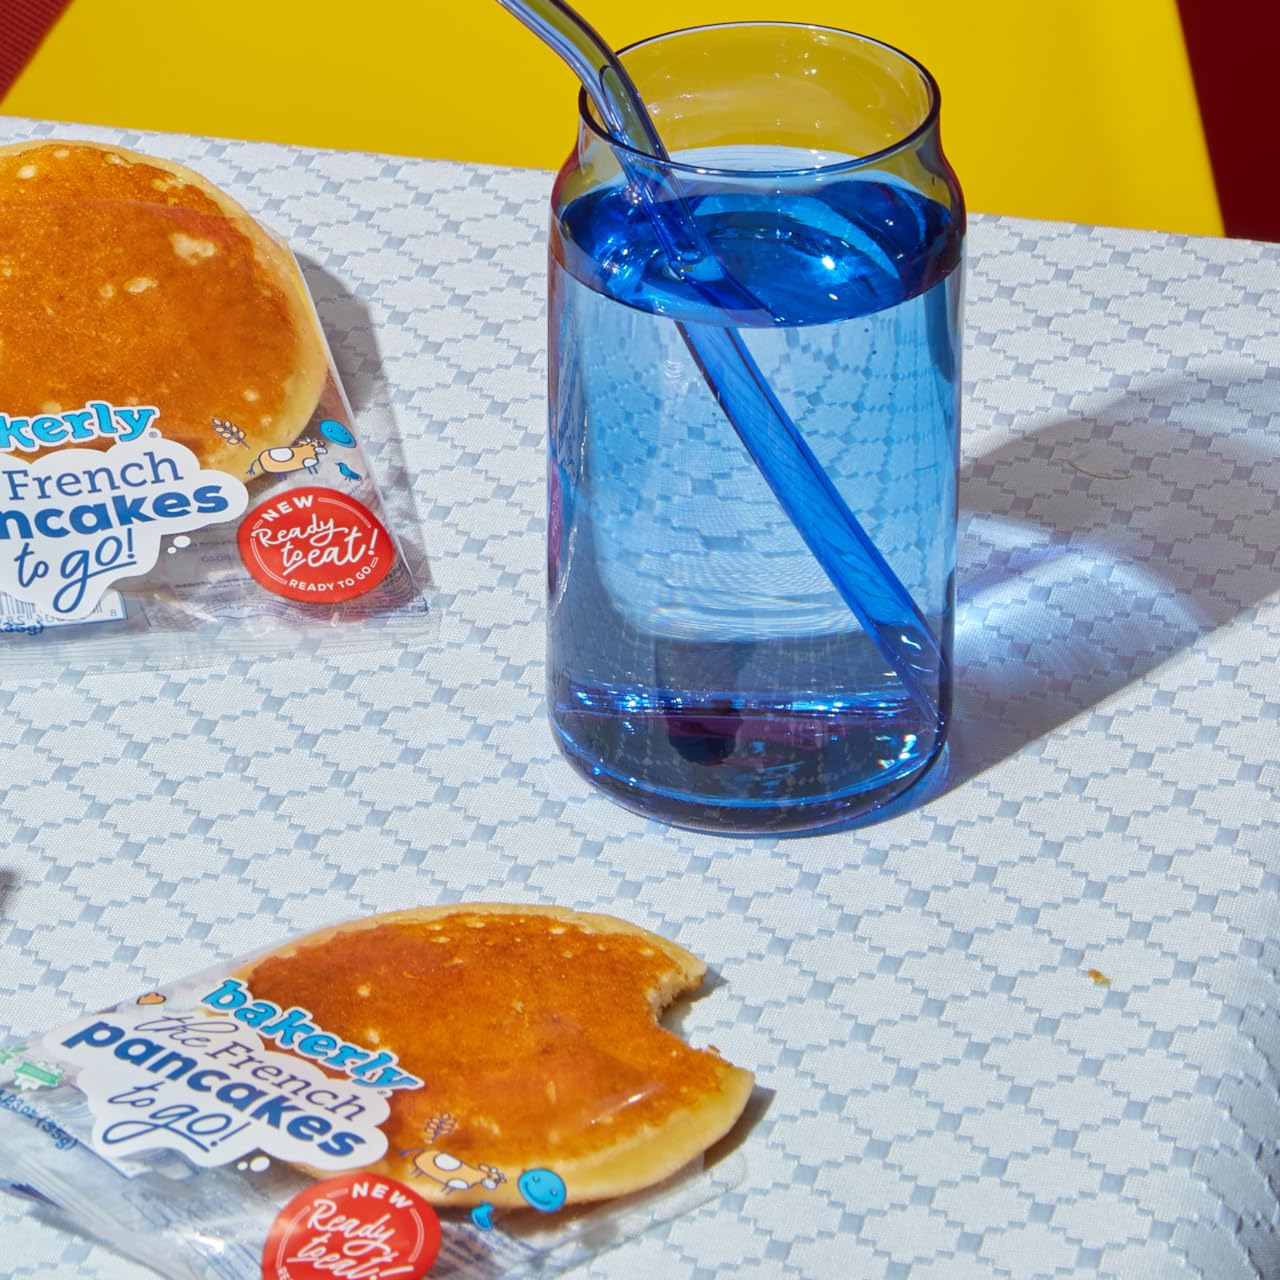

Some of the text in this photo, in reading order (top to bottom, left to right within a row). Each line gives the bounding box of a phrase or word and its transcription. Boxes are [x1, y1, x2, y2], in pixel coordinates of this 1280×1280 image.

[2, 451, 184, 501] French
[251, 513, 348, 547] Ready
[261, 494, 314, 522] NEW
[14, 542, 48, 588] to
[52, 527, 137, 614] go!
[281, 525, 378, 571] to eat!
[289, 565, 371, 592] READY TO GO
[202, 979, 418, 1088] bakerly
[61, 1021, 367, 1157] pancakes
[134, 1015, 367, 1122] the French
[102, 1081, 251, 1153] to go!
[352, 1181, 413, 1209] NEW
[307, 1198, 396, 1256] Ready
